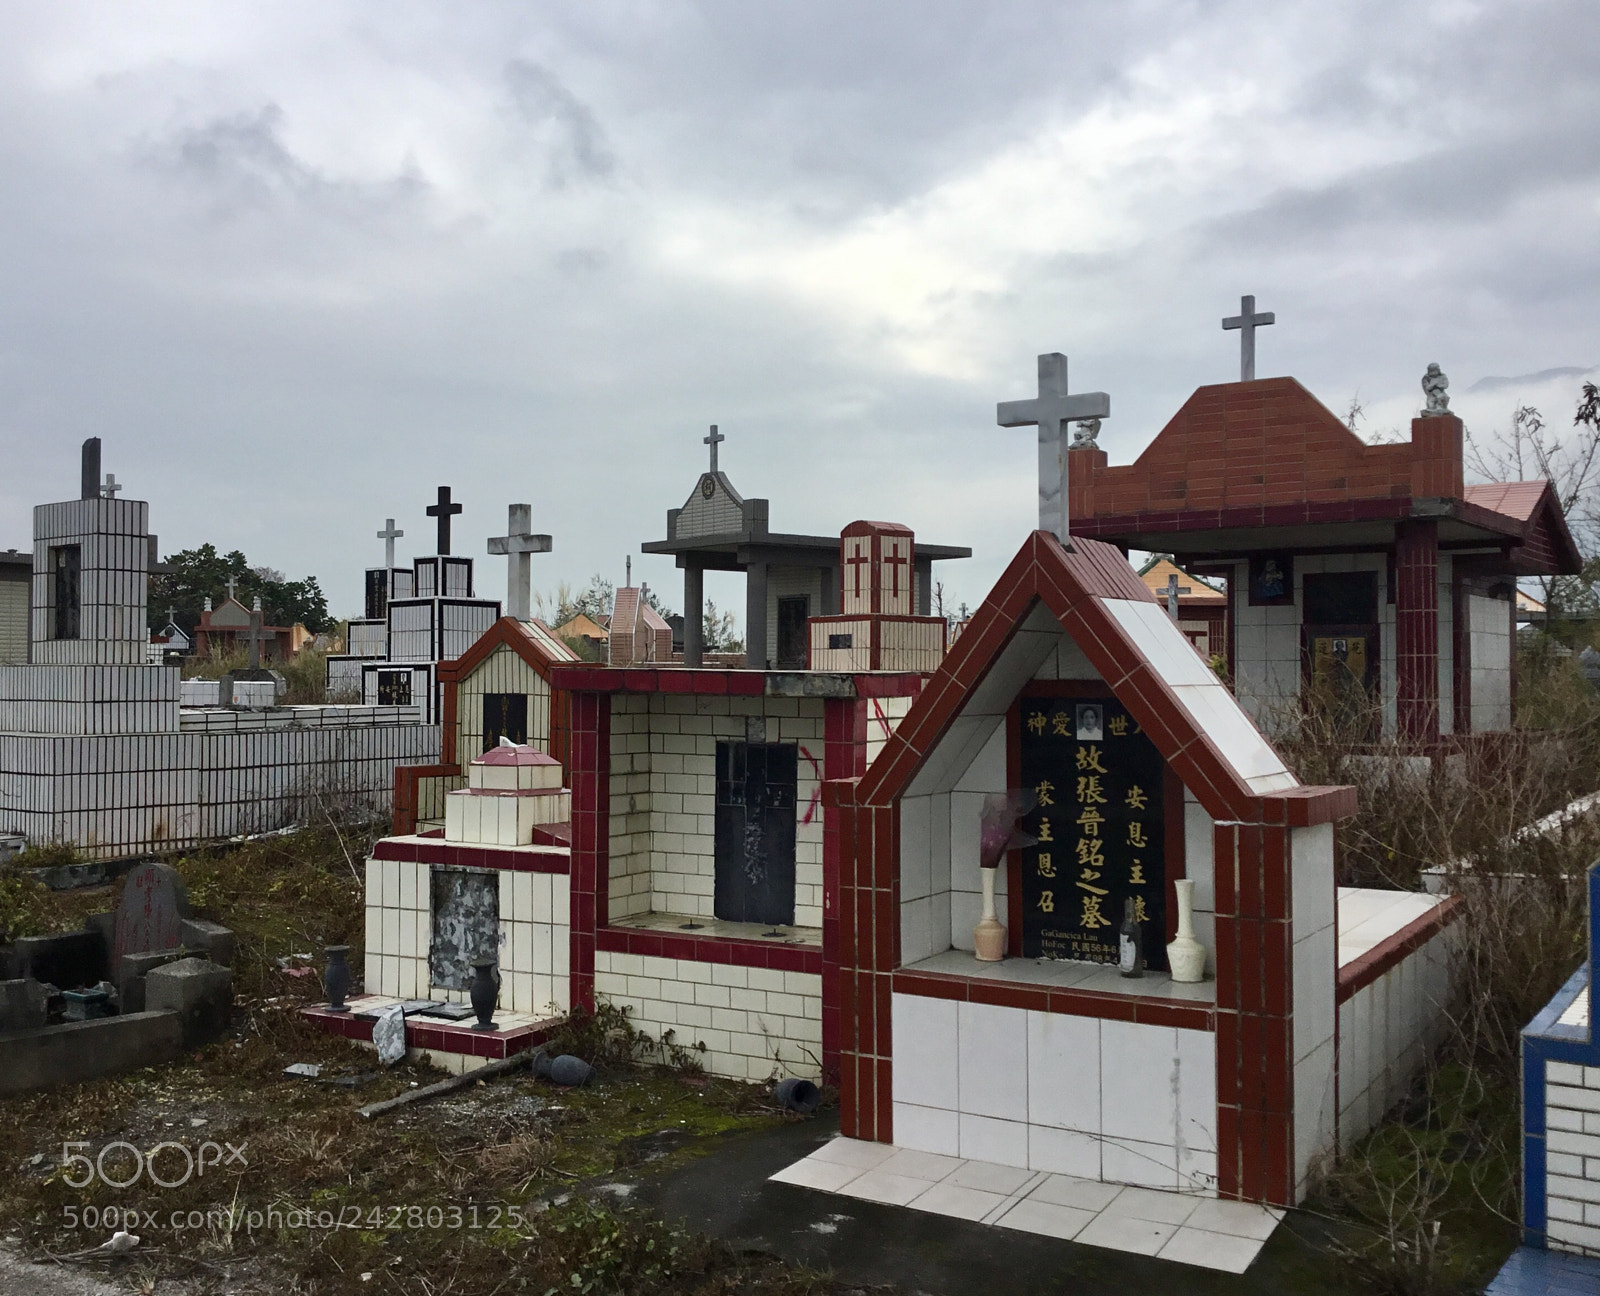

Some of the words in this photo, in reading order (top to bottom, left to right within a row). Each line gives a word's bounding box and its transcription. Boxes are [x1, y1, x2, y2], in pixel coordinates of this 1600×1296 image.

[1035, 780, 1057, 913] 蒙主恩召
[1075, 745, 1111, 929] 故張晉銘之墓
